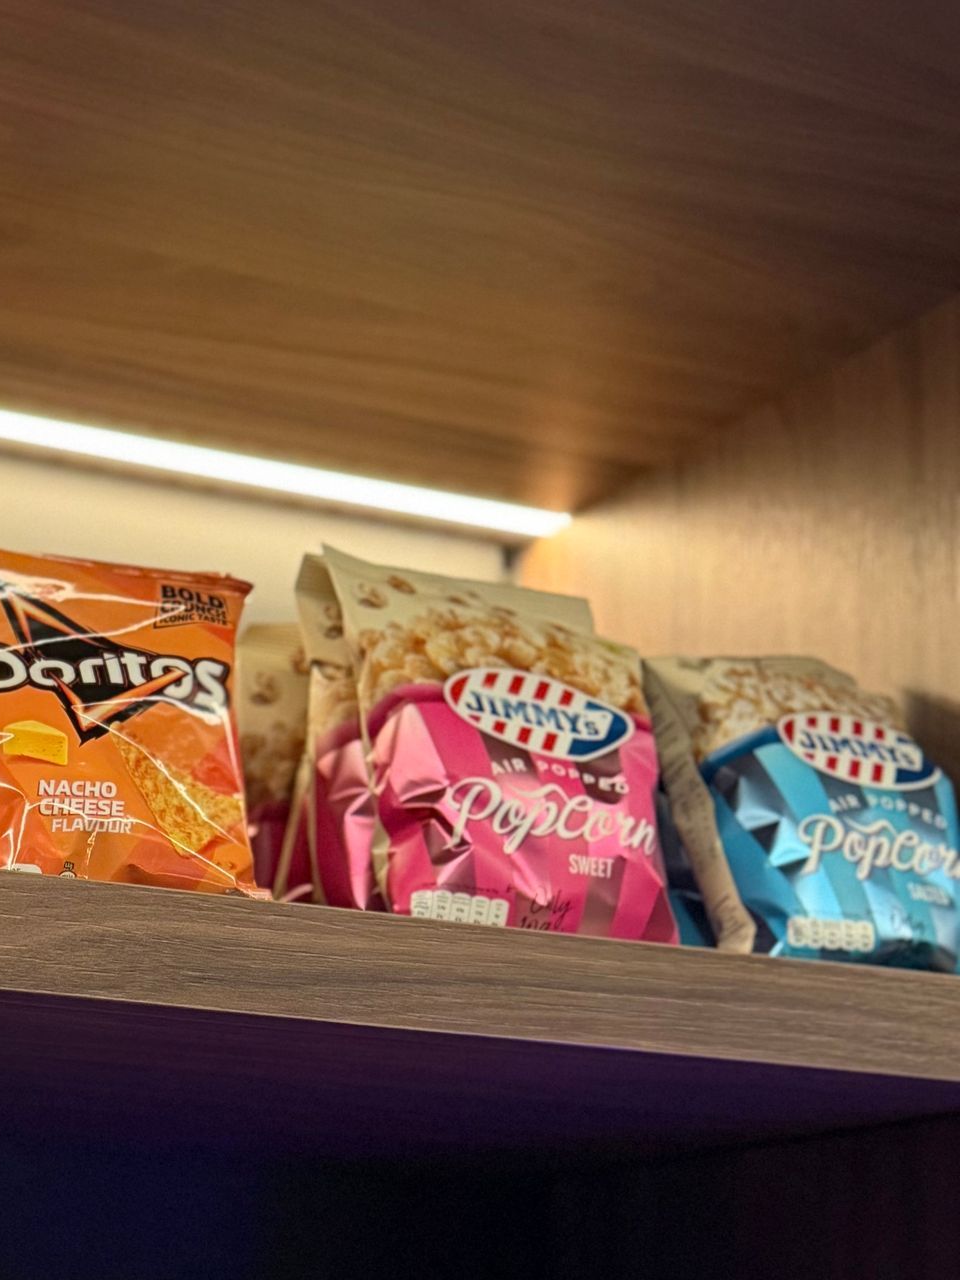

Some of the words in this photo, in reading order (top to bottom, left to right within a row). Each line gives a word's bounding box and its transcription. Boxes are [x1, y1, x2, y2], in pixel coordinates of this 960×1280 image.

[161, 584, 224, 610] BOLD
[491, 758, 528, 776] AIR
[537, 760, 630, 794] POPPED
[38, 780, 117, 797] NACHO
[39, 798, 125, 817] CHEESE
[52, 817, 132, 834] FLAVOUR
[568, 854, 615, 879] SWEET
